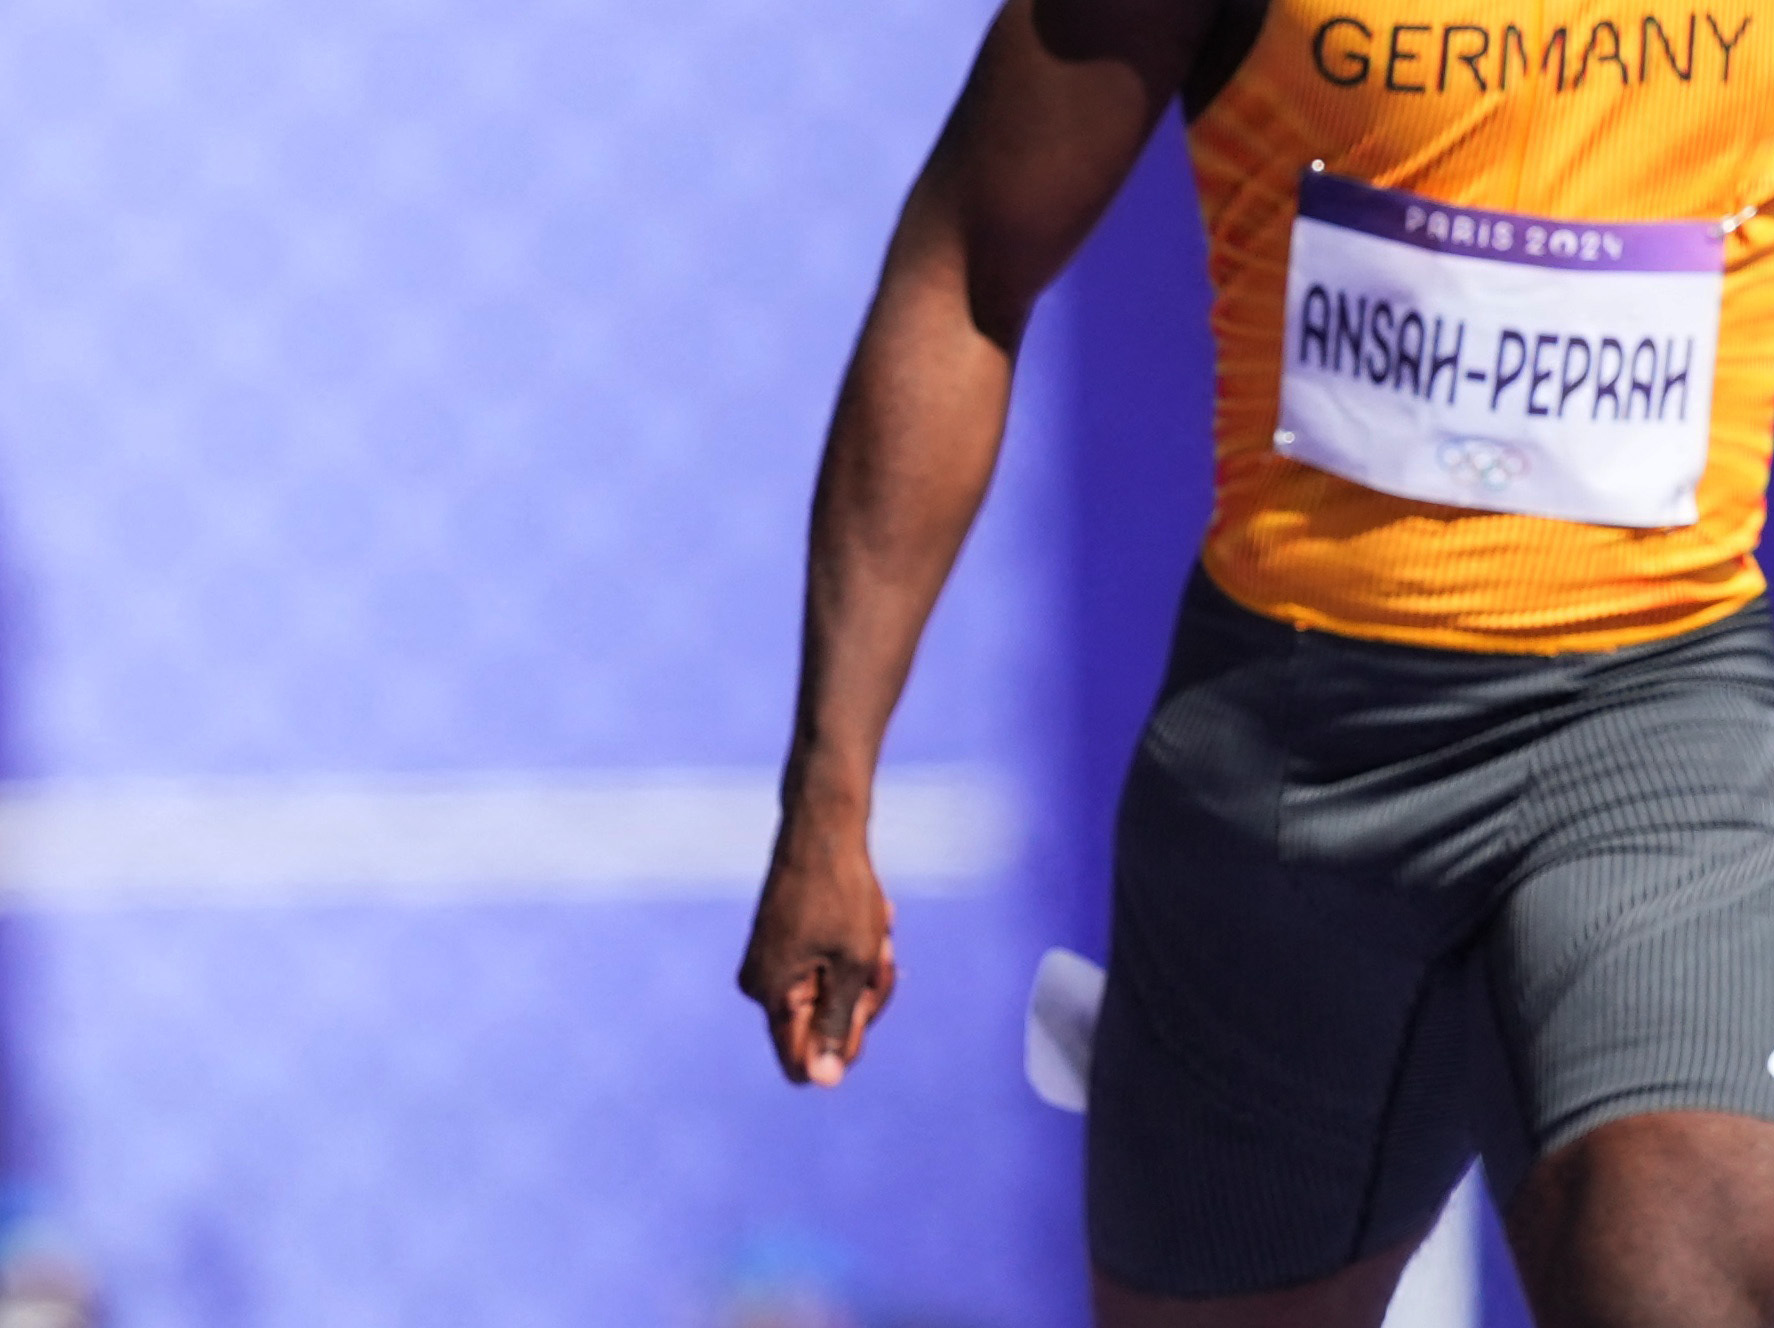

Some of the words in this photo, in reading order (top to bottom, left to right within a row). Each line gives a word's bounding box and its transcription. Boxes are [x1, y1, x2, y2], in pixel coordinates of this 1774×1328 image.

[1310, 13, 1752, 94] GERMANY
[1404, 204, 1514, 252] PARIS
[1524, 225, 1624, 260] 2024
[1300, 282, 1695, 423] ANSAH-PEPRAH
